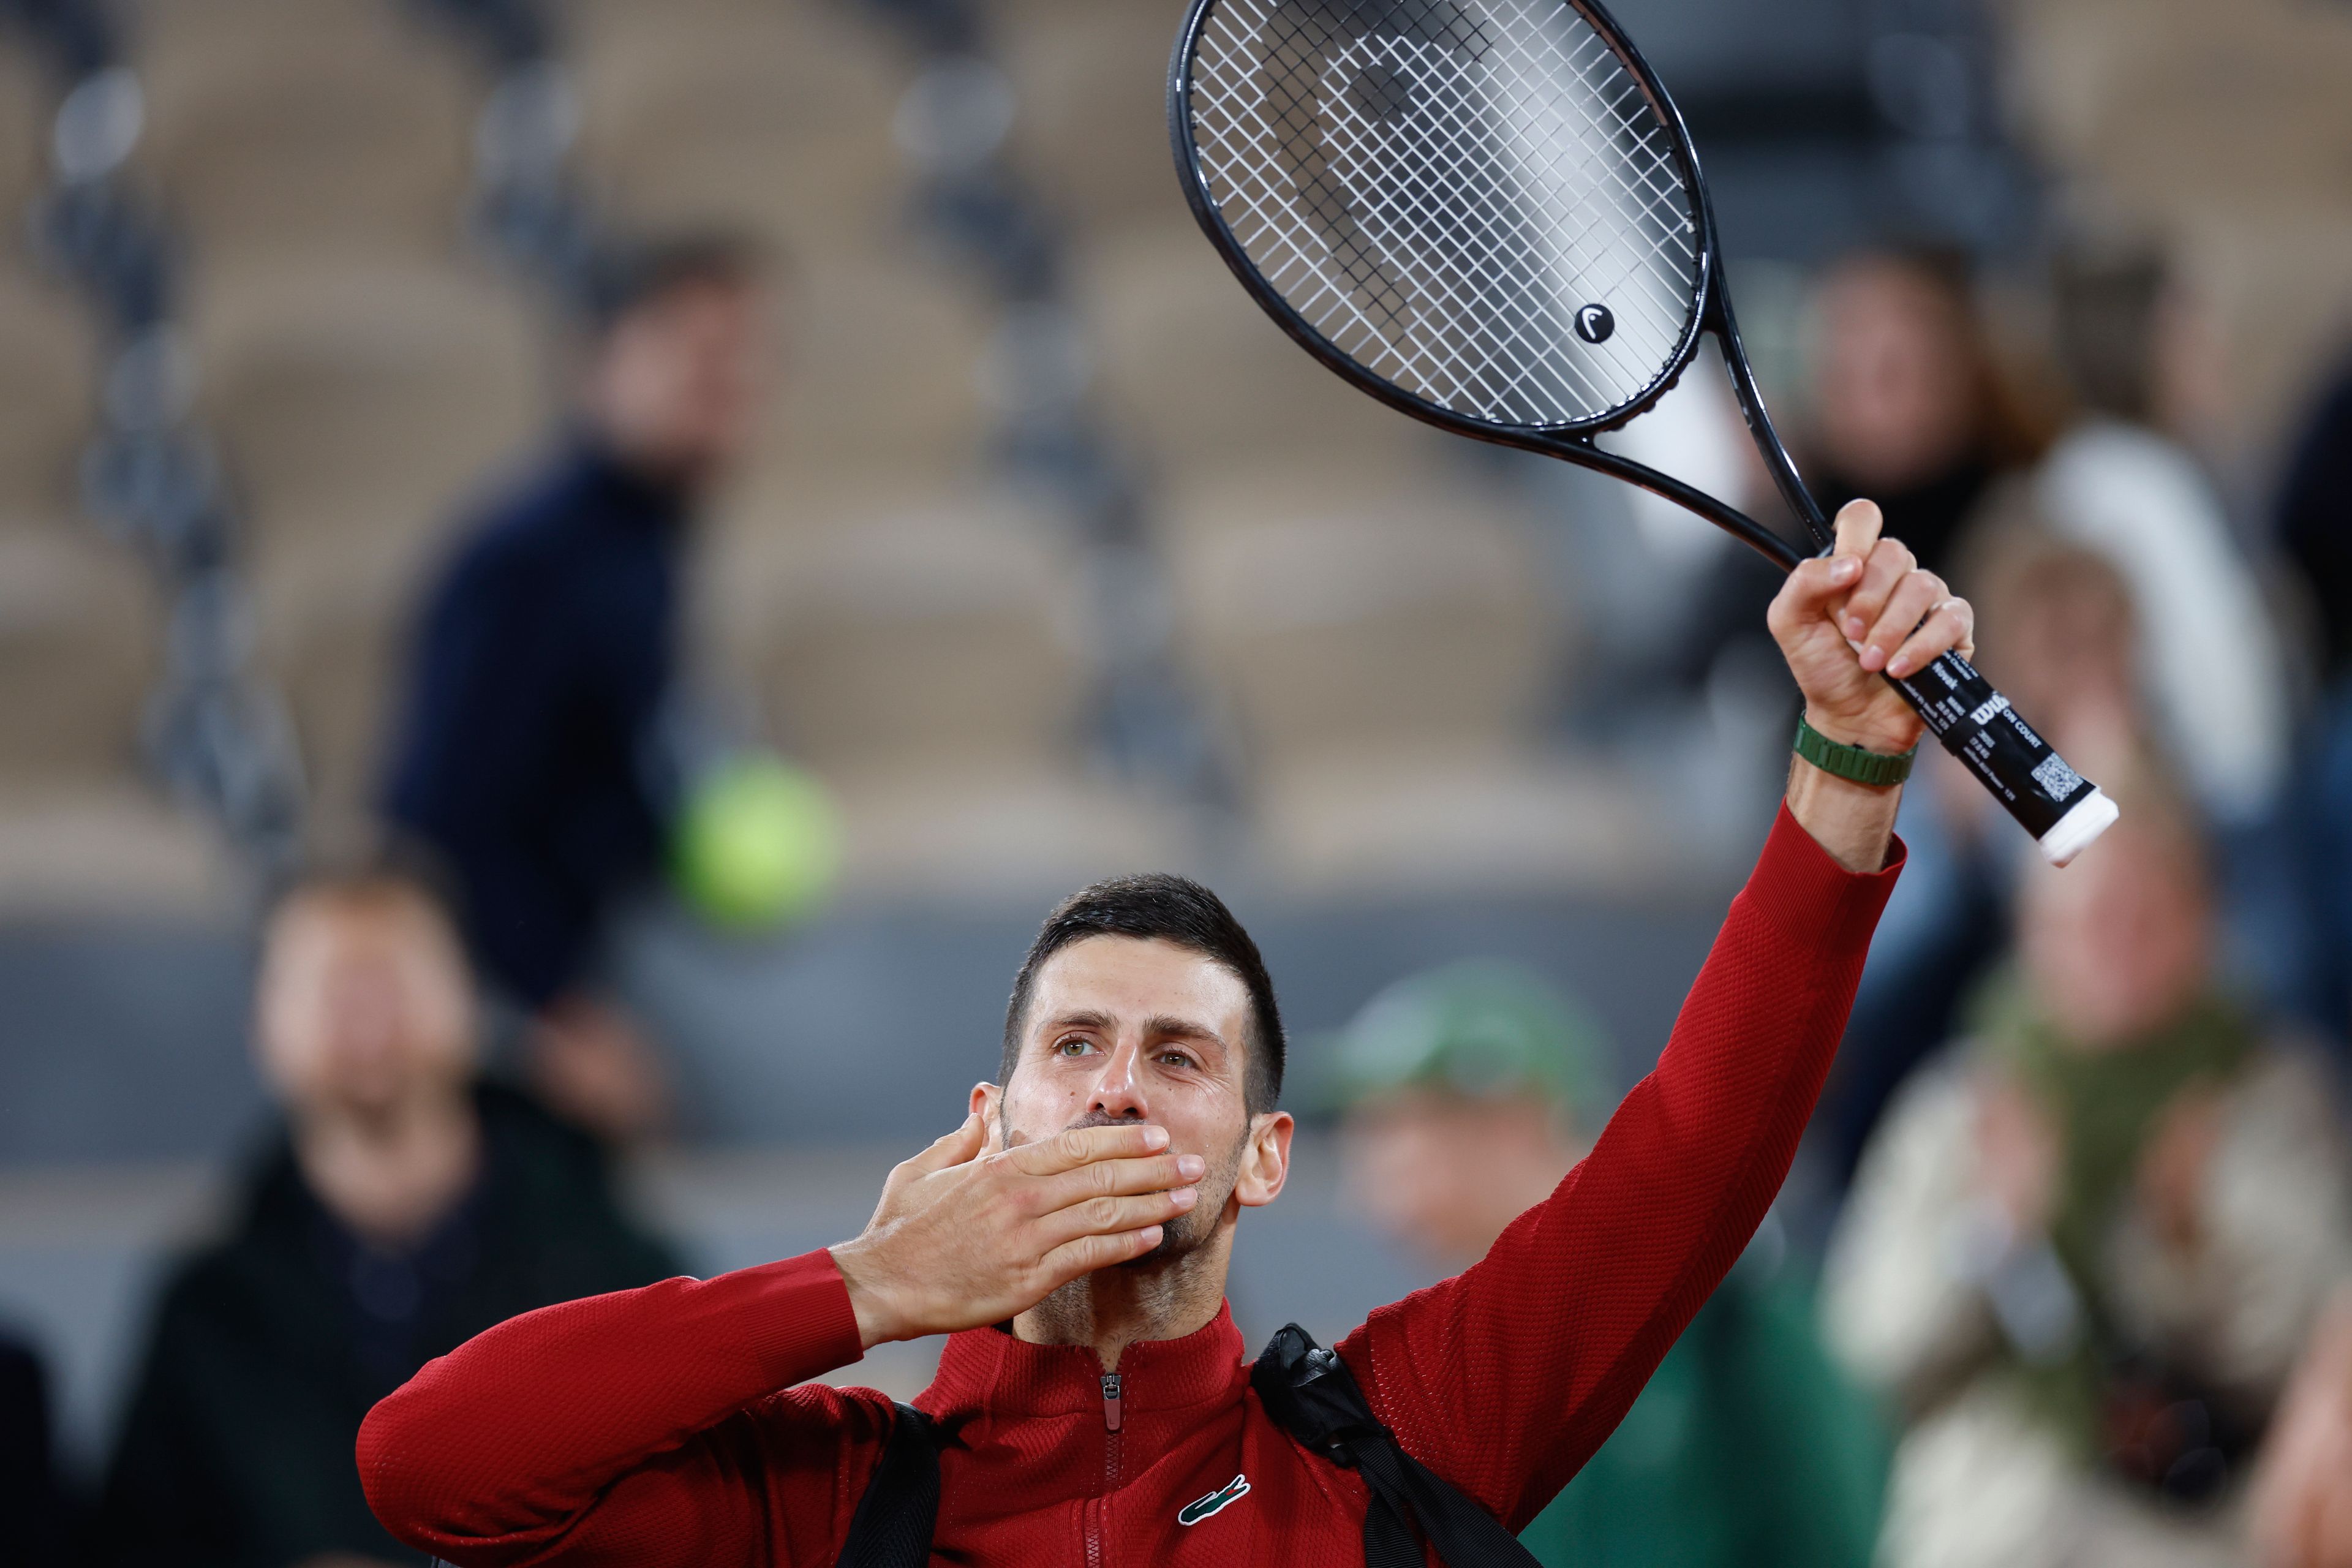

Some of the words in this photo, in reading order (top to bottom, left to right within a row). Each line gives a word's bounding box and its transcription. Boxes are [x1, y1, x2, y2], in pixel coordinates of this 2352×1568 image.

[1932, 662, 1958, 690] Novak
[1947, 696, 1966, 716] MAINS
[2003, 706, 2017, 723] ON
[2015, 721, 2041, 748] COURT
